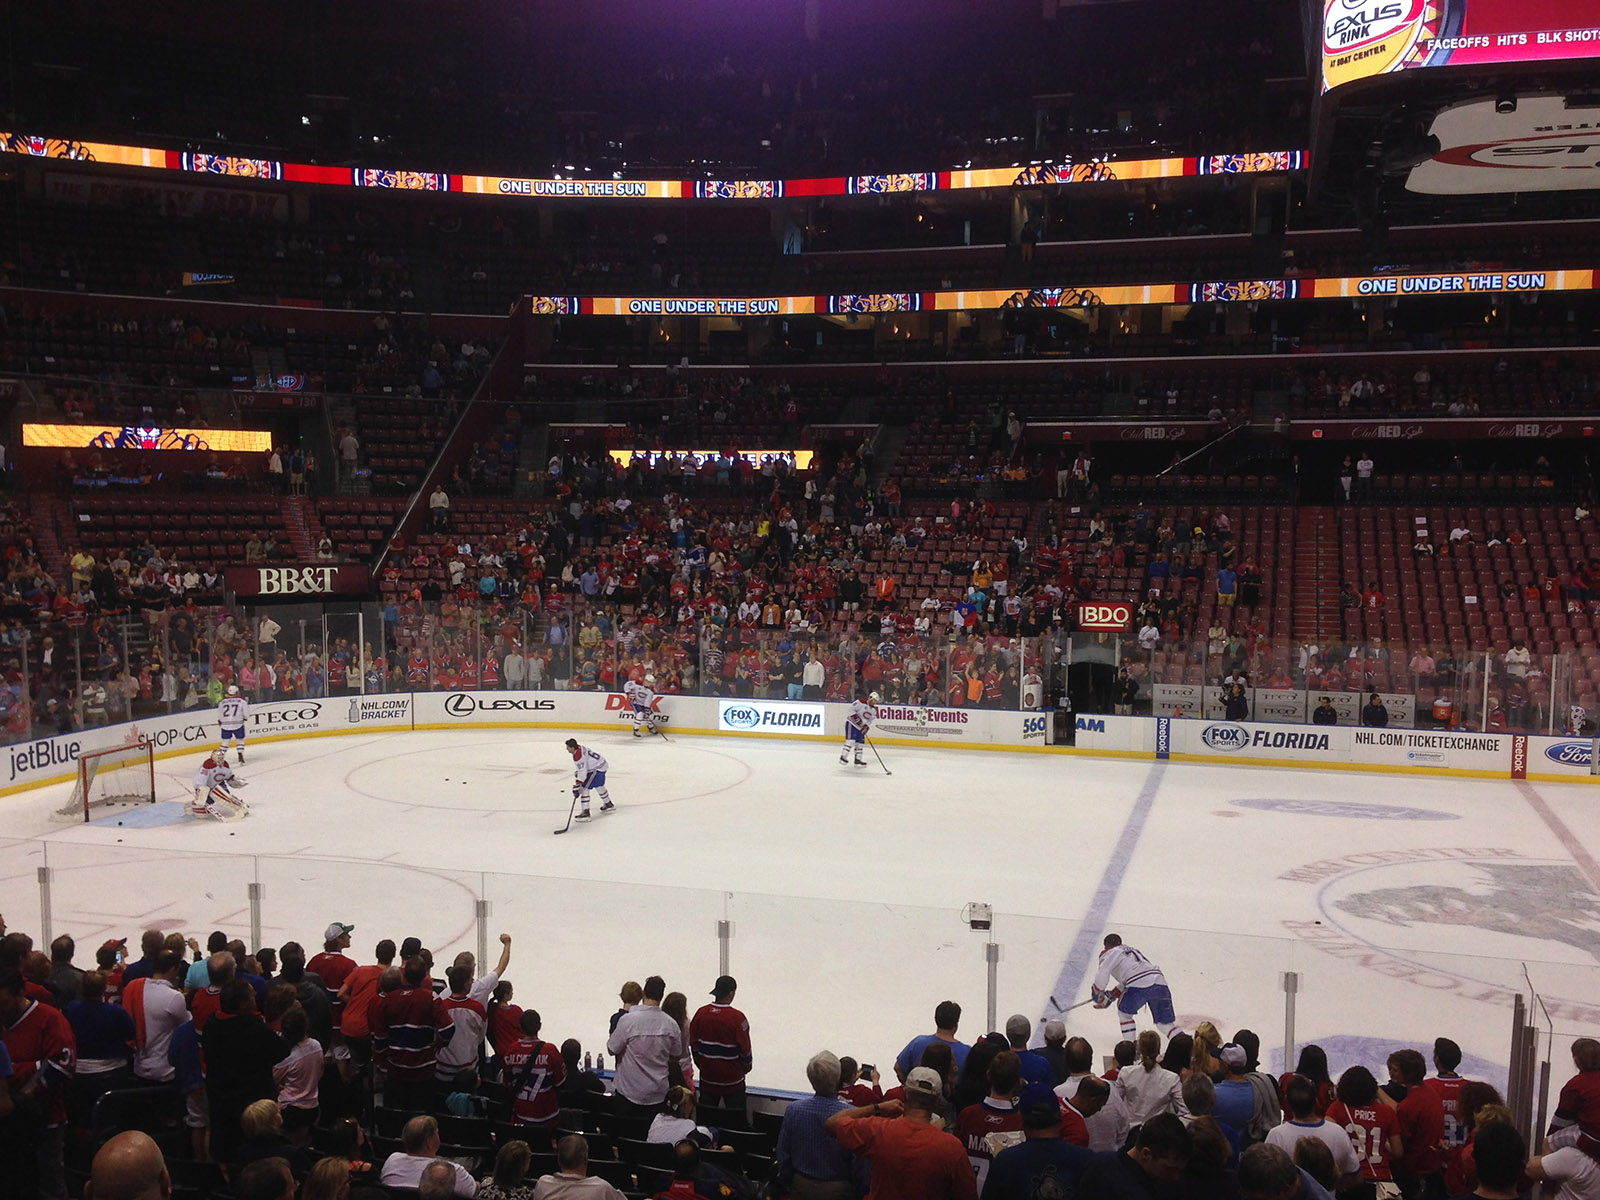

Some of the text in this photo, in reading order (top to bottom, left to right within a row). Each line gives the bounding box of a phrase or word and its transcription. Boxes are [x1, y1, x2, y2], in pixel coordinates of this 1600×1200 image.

[1327, 3, 1402, 39] LEXUS
[1339, 24, 1371, 45] RINK
[1427, 37, 1490, 51] FACEOFFS
[1497, 35, 1528, 46] HITS
[1537, 32, 1562, 44] BLK
[1353, 45, 1386, 61] CENTER
[499, 180, 646, 195] ONE UNDER THE SUN
[1358, 274, 1545, 293] ONE UNDER THE SUN
[629, 299, 779, 313] ONE UNDER THE SUN
[1377, 425, 1401, 437] RED
[1515, 424, 1540, 436] RED
[257, 567, 338, 594] BB&T
[1160, 687, 1194, 696] TECO
[1262, 692, 1299, 701] TECO
[223, 704, 239, 717] 27
[361, 700, 409, 710] NHL.COM/
[478, 700, 555, 710] LEXUS
[1263, 706, 1298, 715] TECO
[249, 704, 321, 726] TECO
[361, 710, 407, 720] BRACKET
[731, 709, 821, 728] FOX FLORIDA
[874, 706, 968, 723] Achaia Events
[249, 722, 320, 735] PEOPLES GAS
[1023, 717, 1105, 733] 560 AM
[1158, 718, 1168, 752] Reebok
[1211, 728, 1329, 750] FOX FLORIDA
[1355, 731, 1501, 752] NHL.COM/TICKETEXCHANGE
[9, 739, 81, 781] jetBlue
[1514, 736, 1525, 772] Reebok
[1560, 744, 1592, 762] For
[1354, 1109, 1377, 1122] PRICE
[1345, 1121, 1383, 1164] 31
